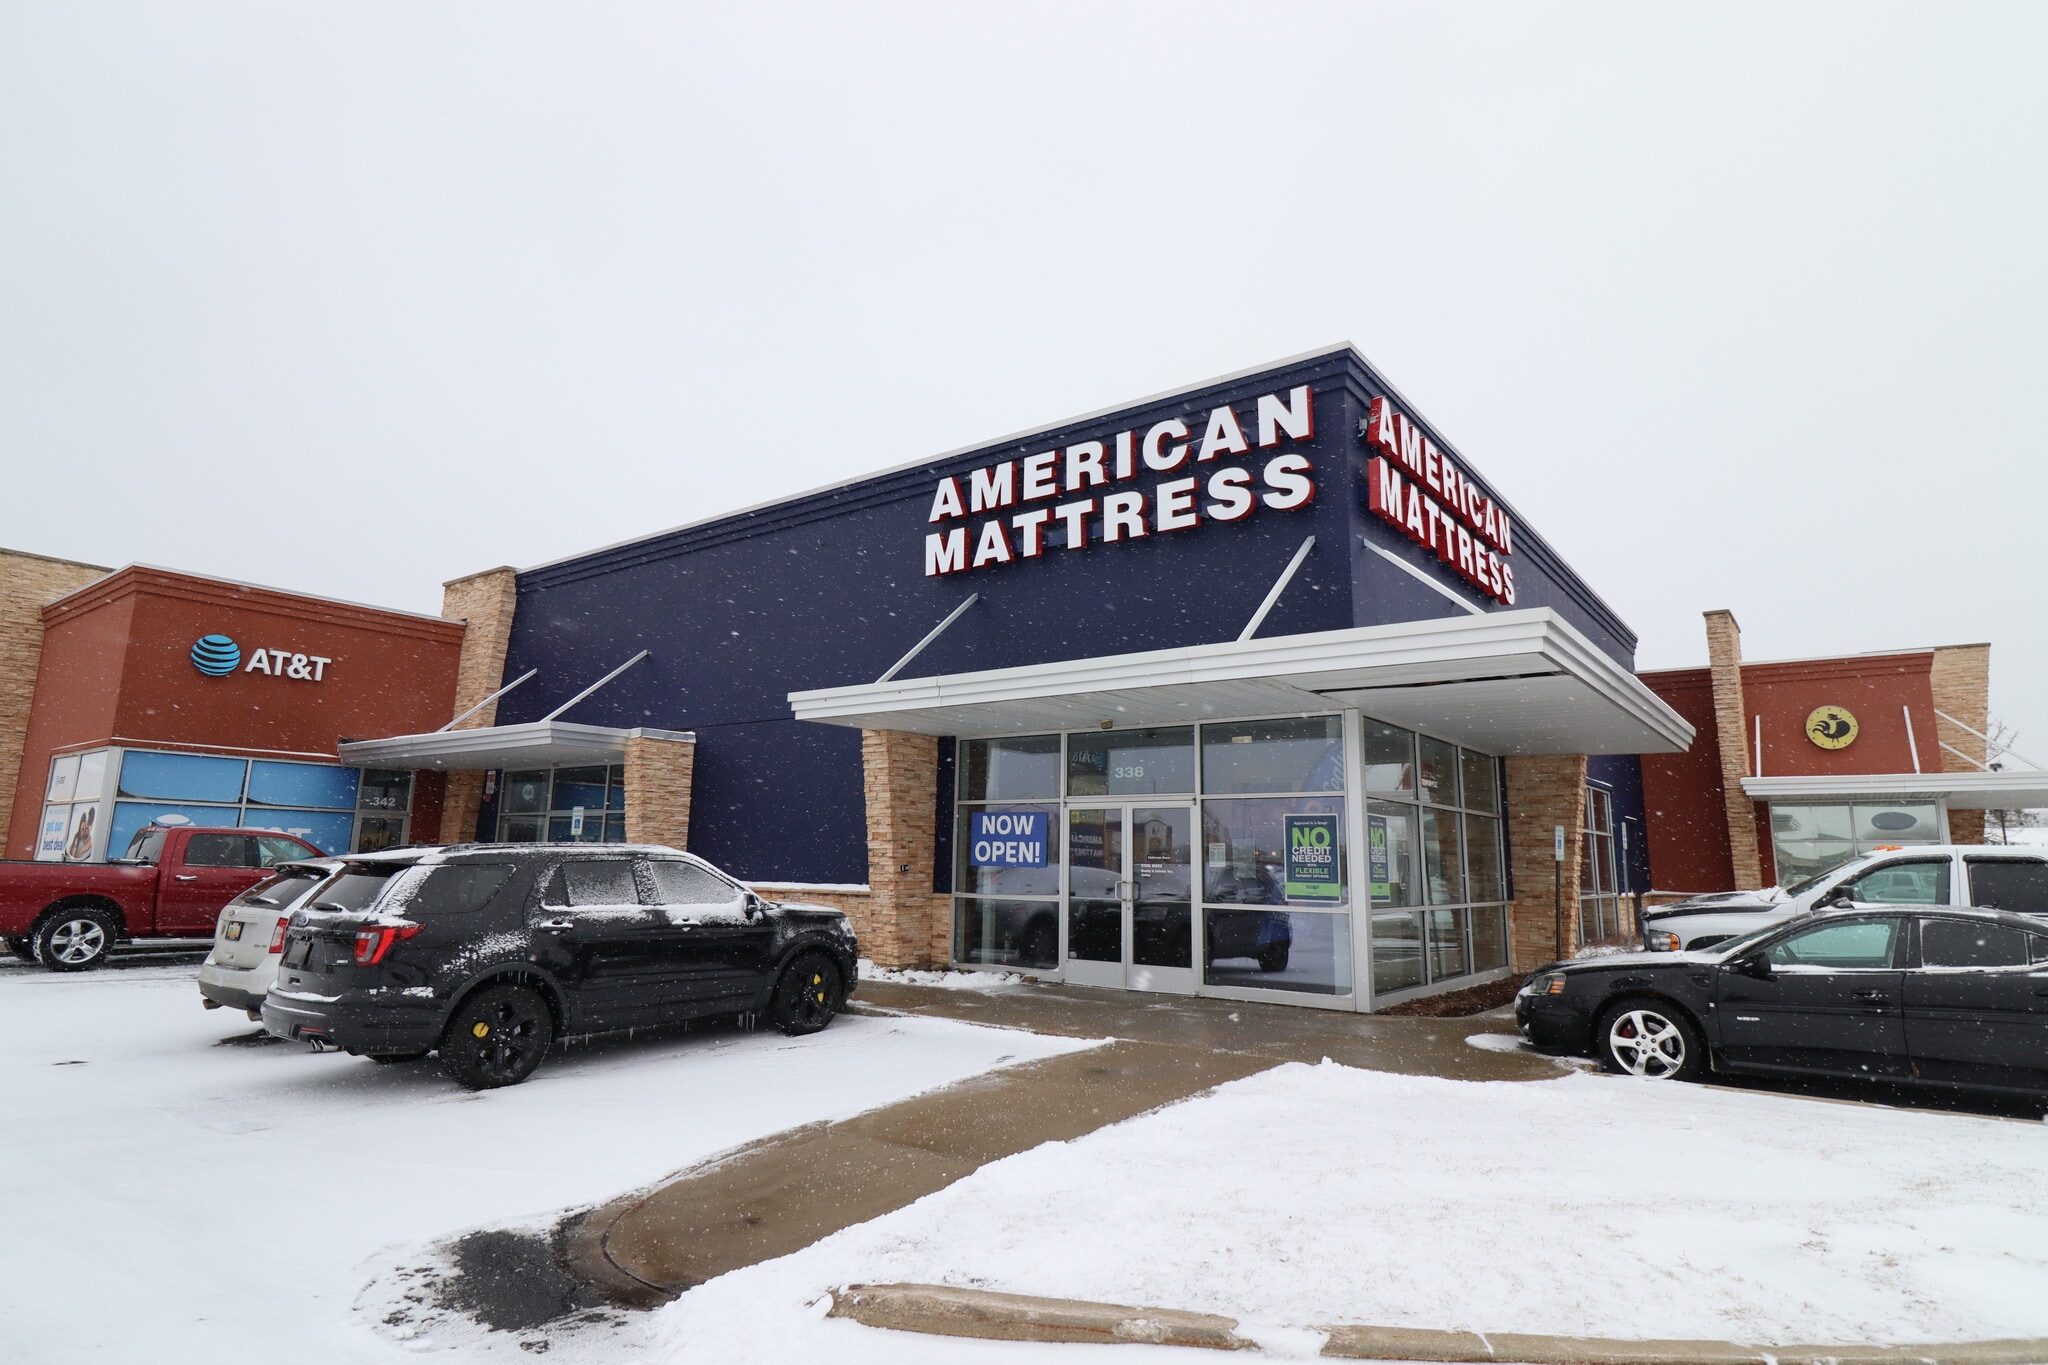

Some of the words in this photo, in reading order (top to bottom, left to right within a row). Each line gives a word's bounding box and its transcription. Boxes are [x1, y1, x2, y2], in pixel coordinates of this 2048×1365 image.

[929, 385, 1313, 522] AMERICAN
[1368, 396, 1512, 555] AMERICAN
[926, 454, 1315, 577] MATTRESS
[1368, 456, 1516, 605] MATTRESS
[244, 648, 332, 681] AT&T
[1114, 766, 1144, 778] 338
[372, 797, 396, 808] 342
[982, 815, 1034, 835] NOW
[1292, 827, 1330, 848] NO
[1370, 827, 1385, 848] NO
[975, 841, 1041, 863] OPEN!
[1292, 846, 1332, 855] CREDIT
